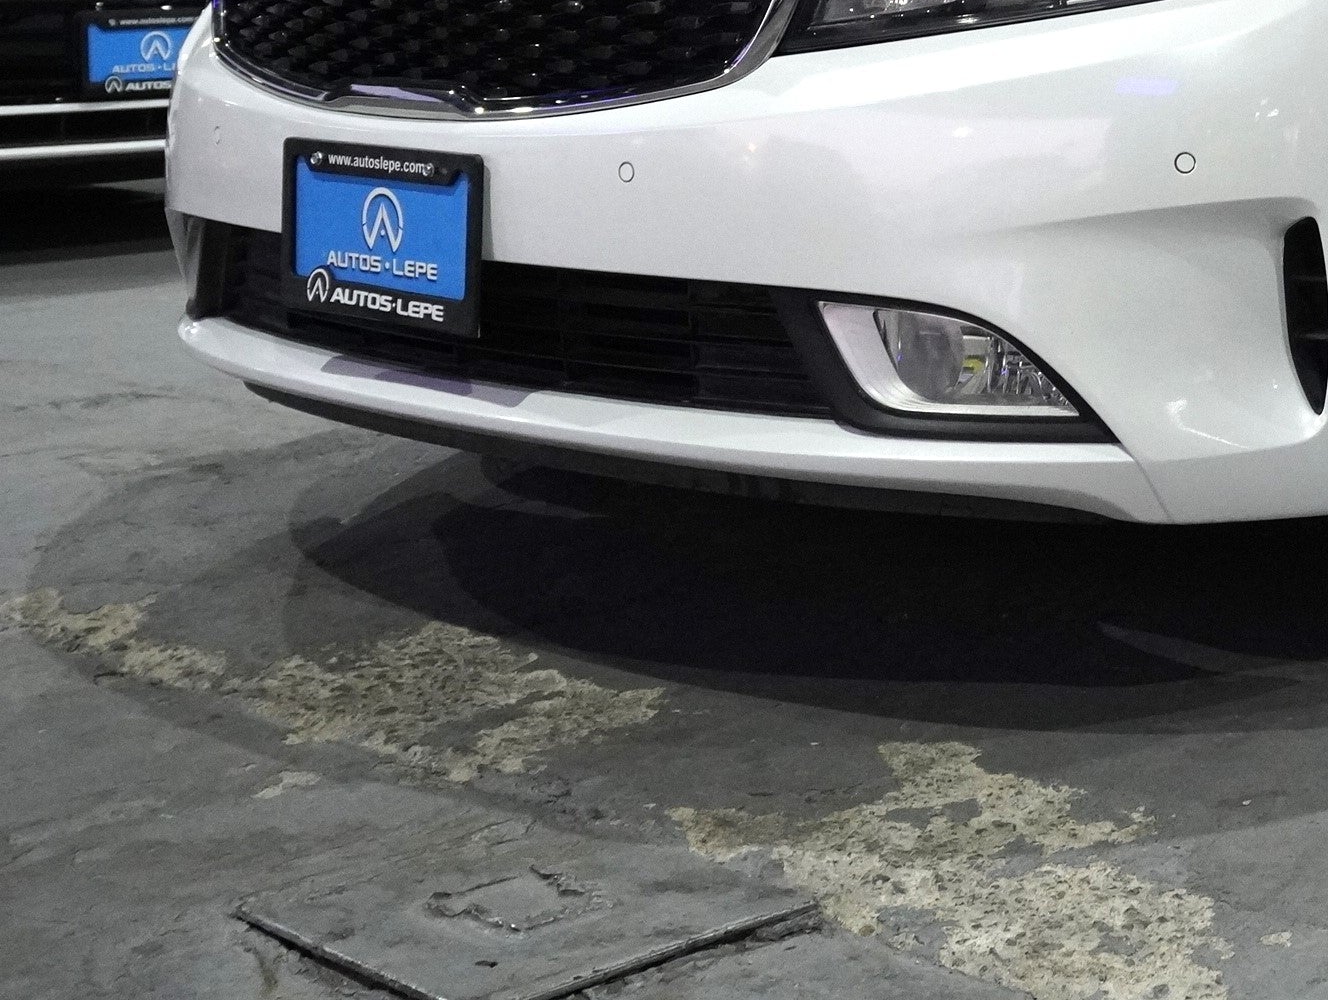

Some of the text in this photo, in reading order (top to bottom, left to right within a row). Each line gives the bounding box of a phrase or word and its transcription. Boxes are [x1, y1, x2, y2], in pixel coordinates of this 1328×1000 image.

[112, 62, 155, 74] AUTOS
[327, 152, 426, 175] www.autoslepe.com
[326, 250, 439, 282] AUTOS LEPE
